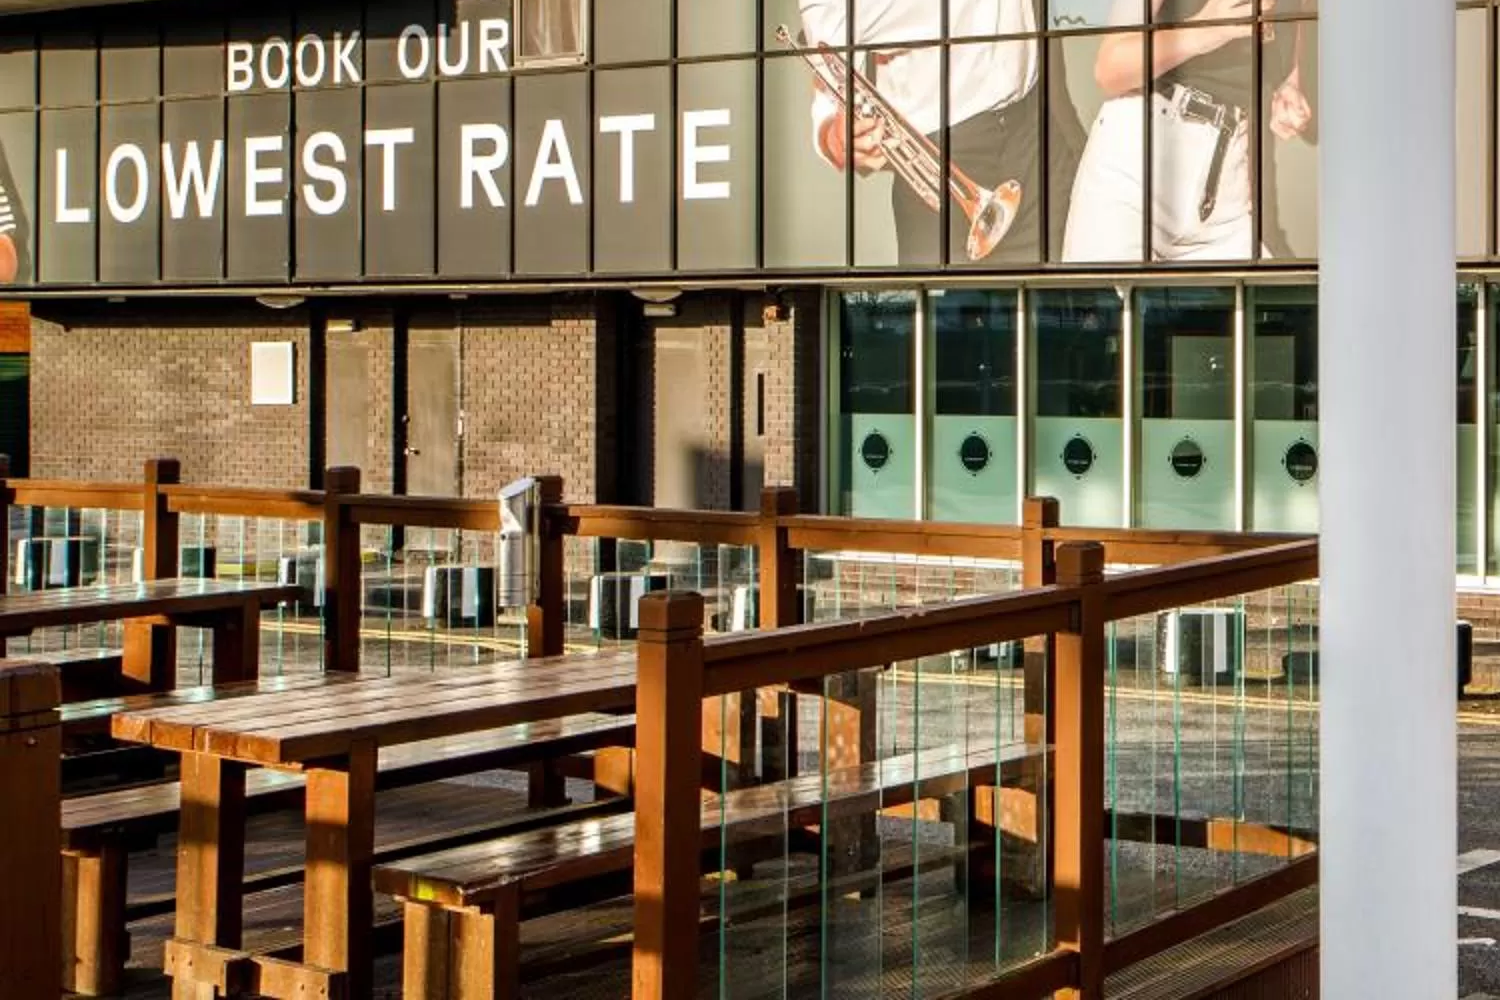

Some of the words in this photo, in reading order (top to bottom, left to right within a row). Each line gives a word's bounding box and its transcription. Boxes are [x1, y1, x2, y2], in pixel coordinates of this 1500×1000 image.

[227, 30, 362, 92] BOOK
[397, 18, 511, 80] OUR
[55, 128, 415, 223] LOWEST
[460, 109, 731, 210] RATE
